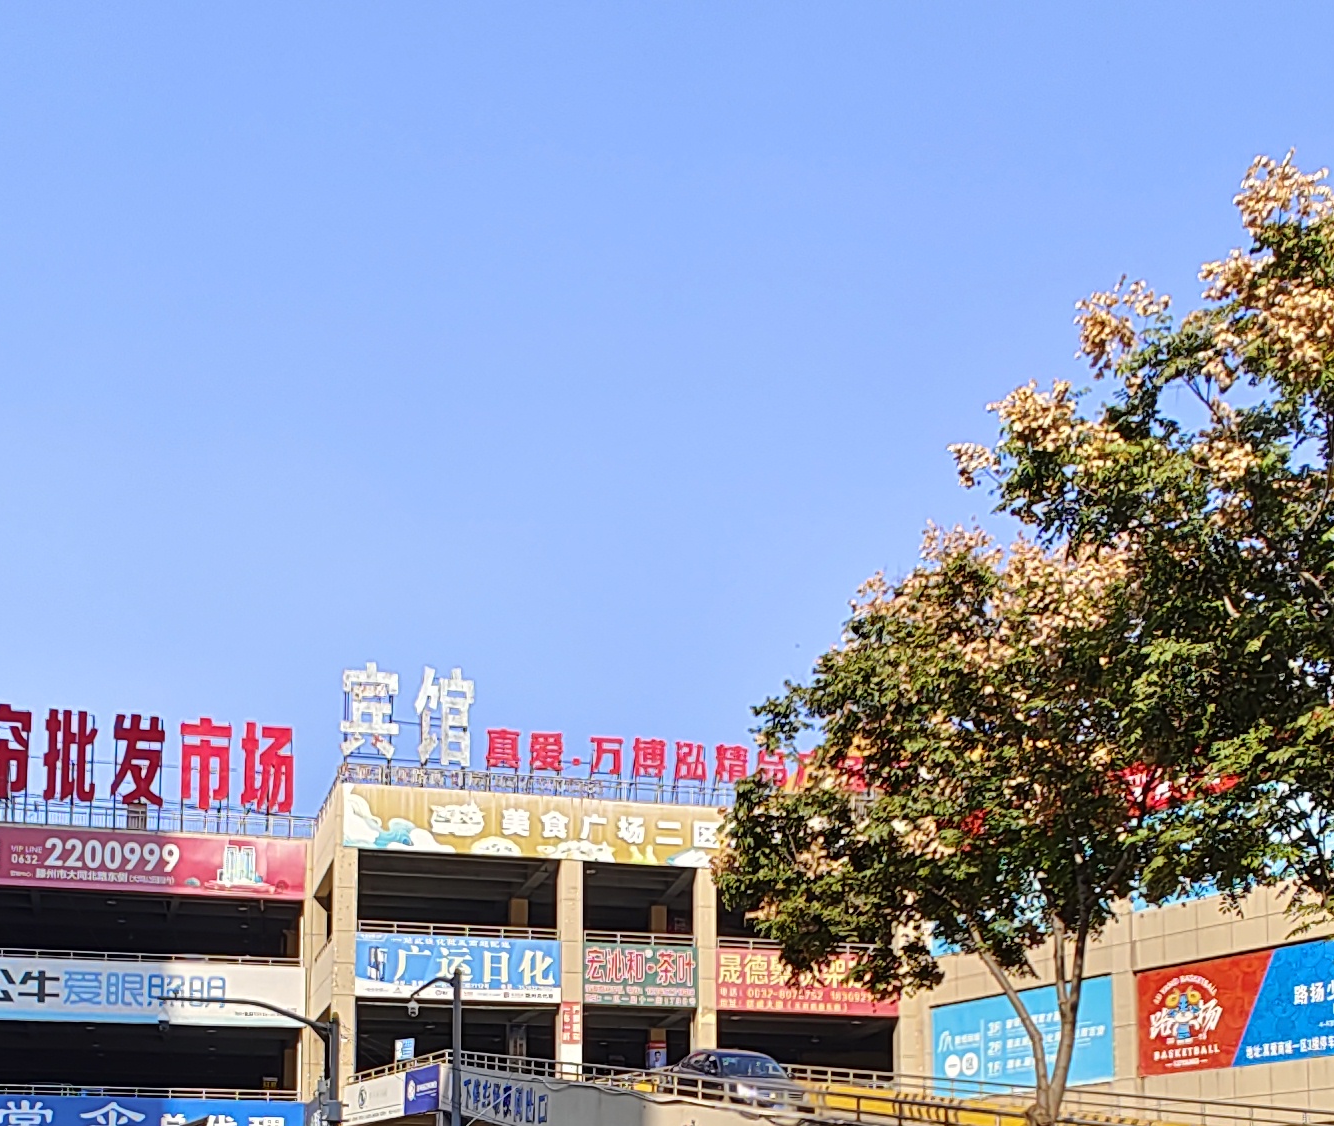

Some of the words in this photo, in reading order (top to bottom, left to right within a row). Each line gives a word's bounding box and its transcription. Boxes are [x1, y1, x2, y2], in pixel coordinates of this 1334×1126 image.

[340, 661, 475, 767] 宾馆
[502, 807, 720, 848] 美食广场二区
[44, 838, 180, 872] 2200999
[394, 945, 555, 986] 广运日化
[1153, 1044, 1220, 1061] BASKETBALL
